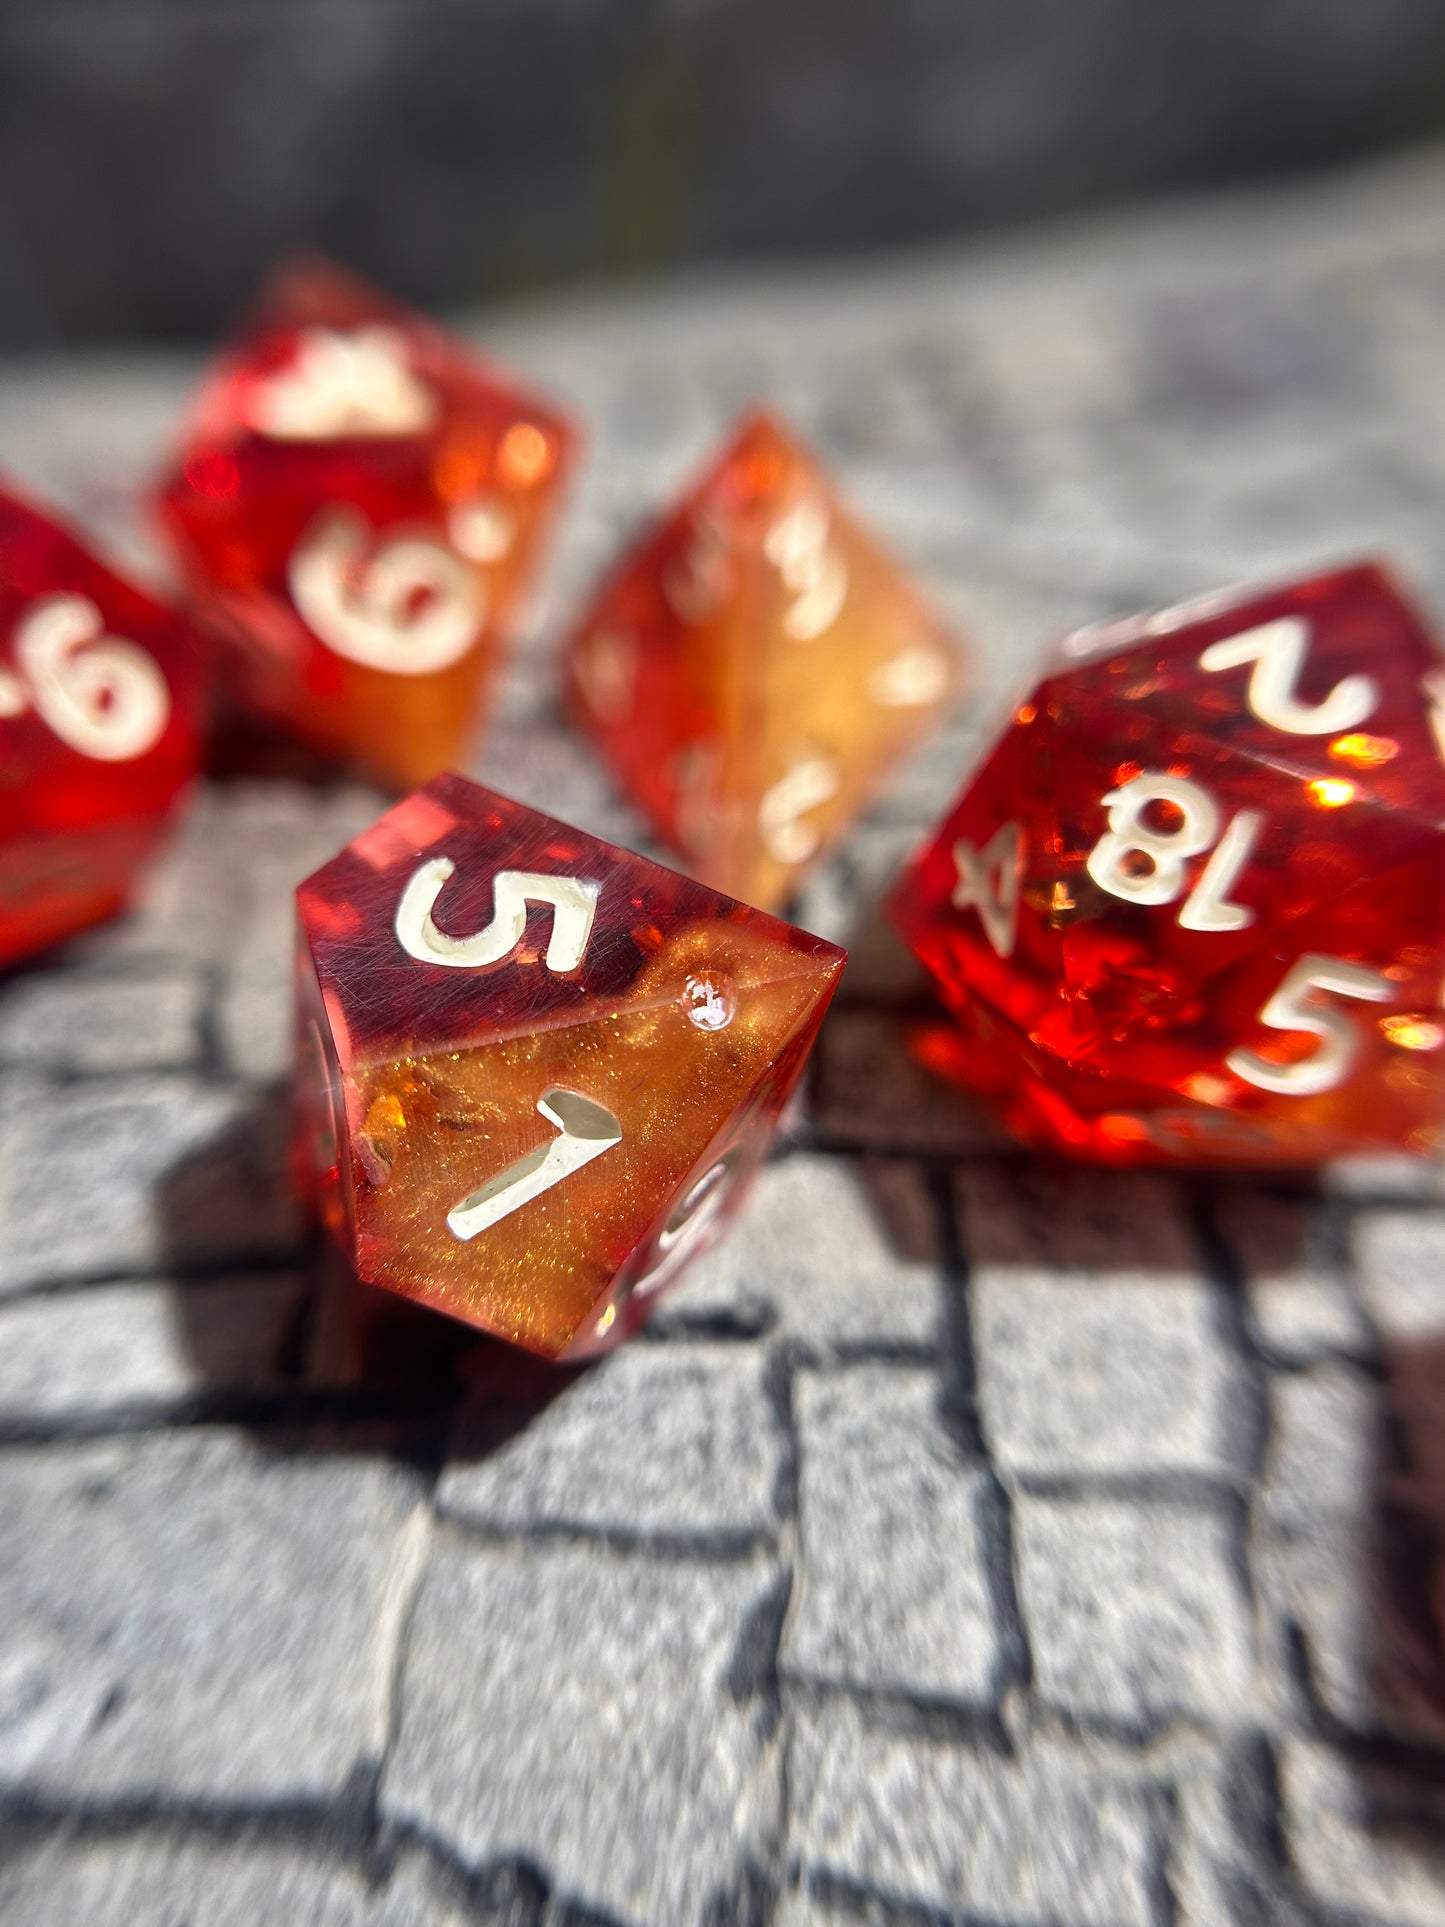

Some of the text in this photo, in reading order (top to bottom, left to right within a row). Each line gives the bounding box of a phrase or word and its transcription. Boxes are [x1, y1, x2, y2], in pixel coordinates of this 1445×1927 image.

[1199, 616, 1380, 735] 2
[396, 856, 601, 973] 5
[1087, 772, 1264, 931] 18
[1226, 952, 1397, 1096] 5
[446, 1088, 623, 1241] 1
